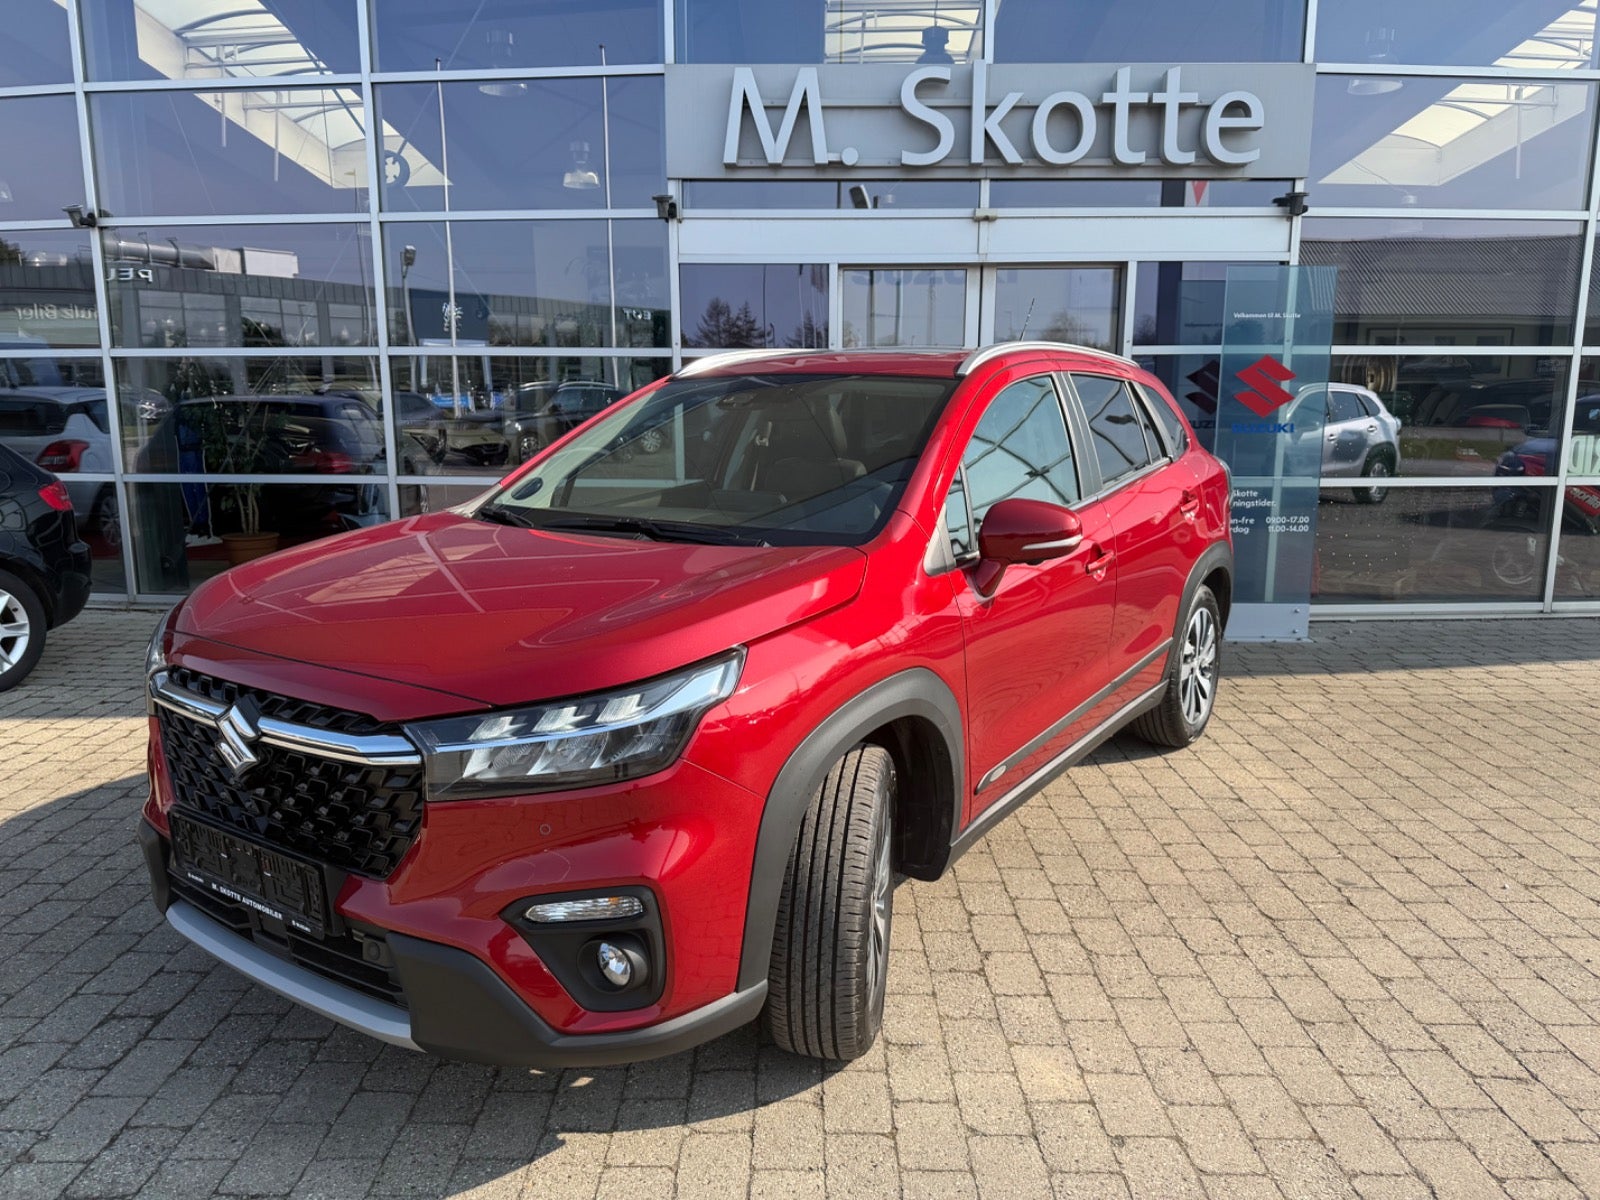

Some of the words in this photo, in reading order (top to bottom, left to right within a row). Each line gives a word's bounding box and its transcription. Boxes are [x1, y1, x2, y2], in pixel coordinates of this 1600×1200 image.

[723, 66, 859, 168] M.
[900, 60, 1265, 167] Skotte
[1231, 423, 1295, 433] SUZUKI
[220, 886, 241, 902] SKOTTE
[241, 897, 283, 920] AUTOMOBILER
